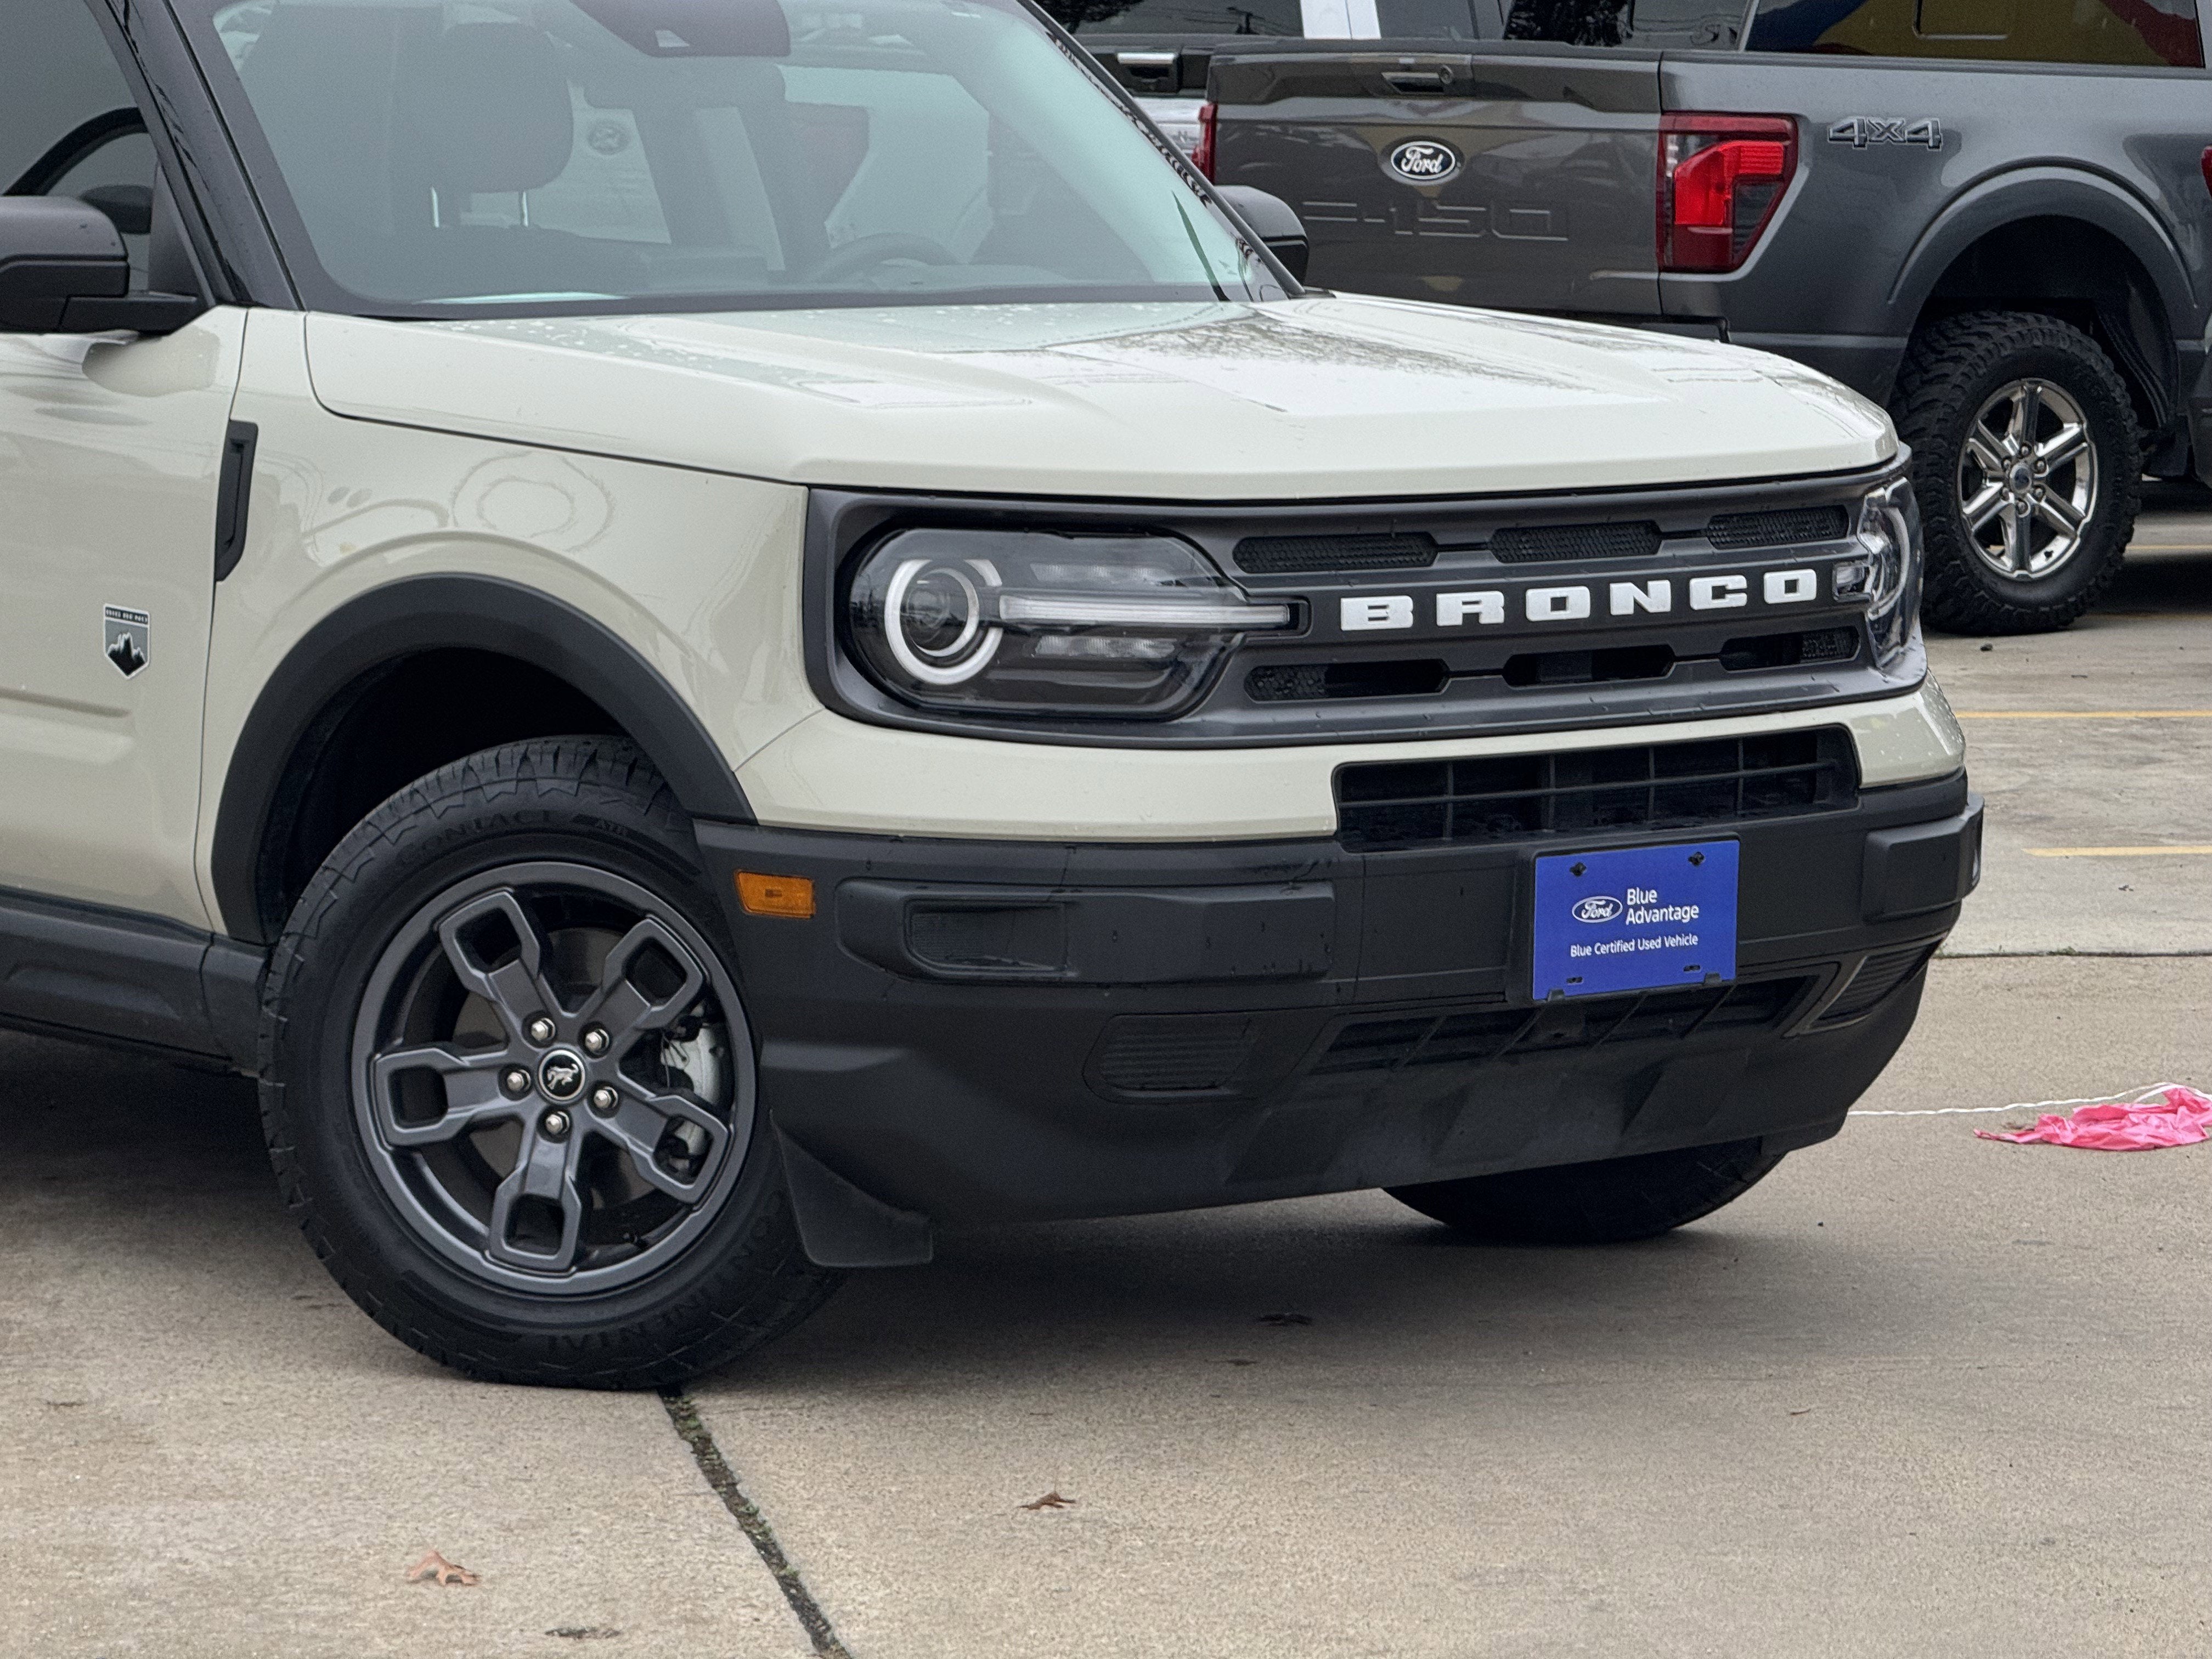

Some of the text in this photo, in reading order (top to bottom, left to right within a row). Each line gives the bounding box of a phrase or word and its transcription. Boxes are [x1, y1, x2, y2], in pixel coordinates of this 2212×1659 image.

[1401, 146, 1444, 172] Ford
[1340, 568, 1817, 631] BRONCO
[1627, 887, 1657, 905] Blue
[1581, 900, 1614, 919] Ford
[1626, 905, 1699, 926] Advantage
[1570, 933, 1699, 957] Blue Certified Used Vehicle
